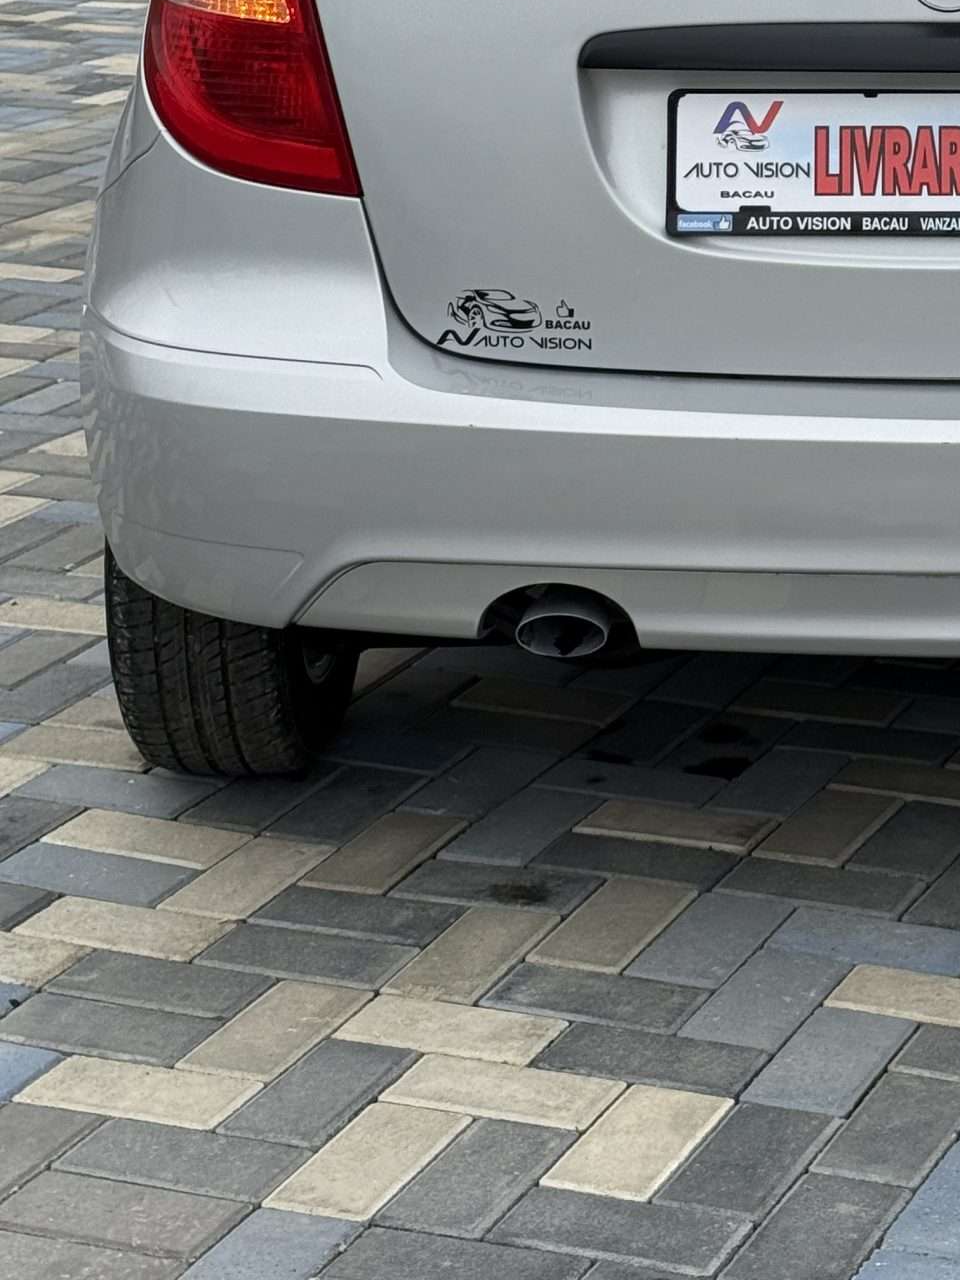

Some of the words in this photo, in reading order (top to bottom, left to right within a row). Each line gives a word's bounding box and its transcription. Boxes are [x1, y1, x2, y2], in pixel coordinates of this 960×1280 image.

[683, 162, 739, 178] AUTO
[743, 162, 811, 178] VISION
[720, 190, 775, 198] BACAU
[746, 217, 793, 230] AUTO
[796, 217, 852, 231] VISION
[862, 217, 909, 231] BACAU
[545, 320, 591, 330] BACAU
[473, 335, 525, 348] AUTO
[529, 336, 593, 351] VISION
